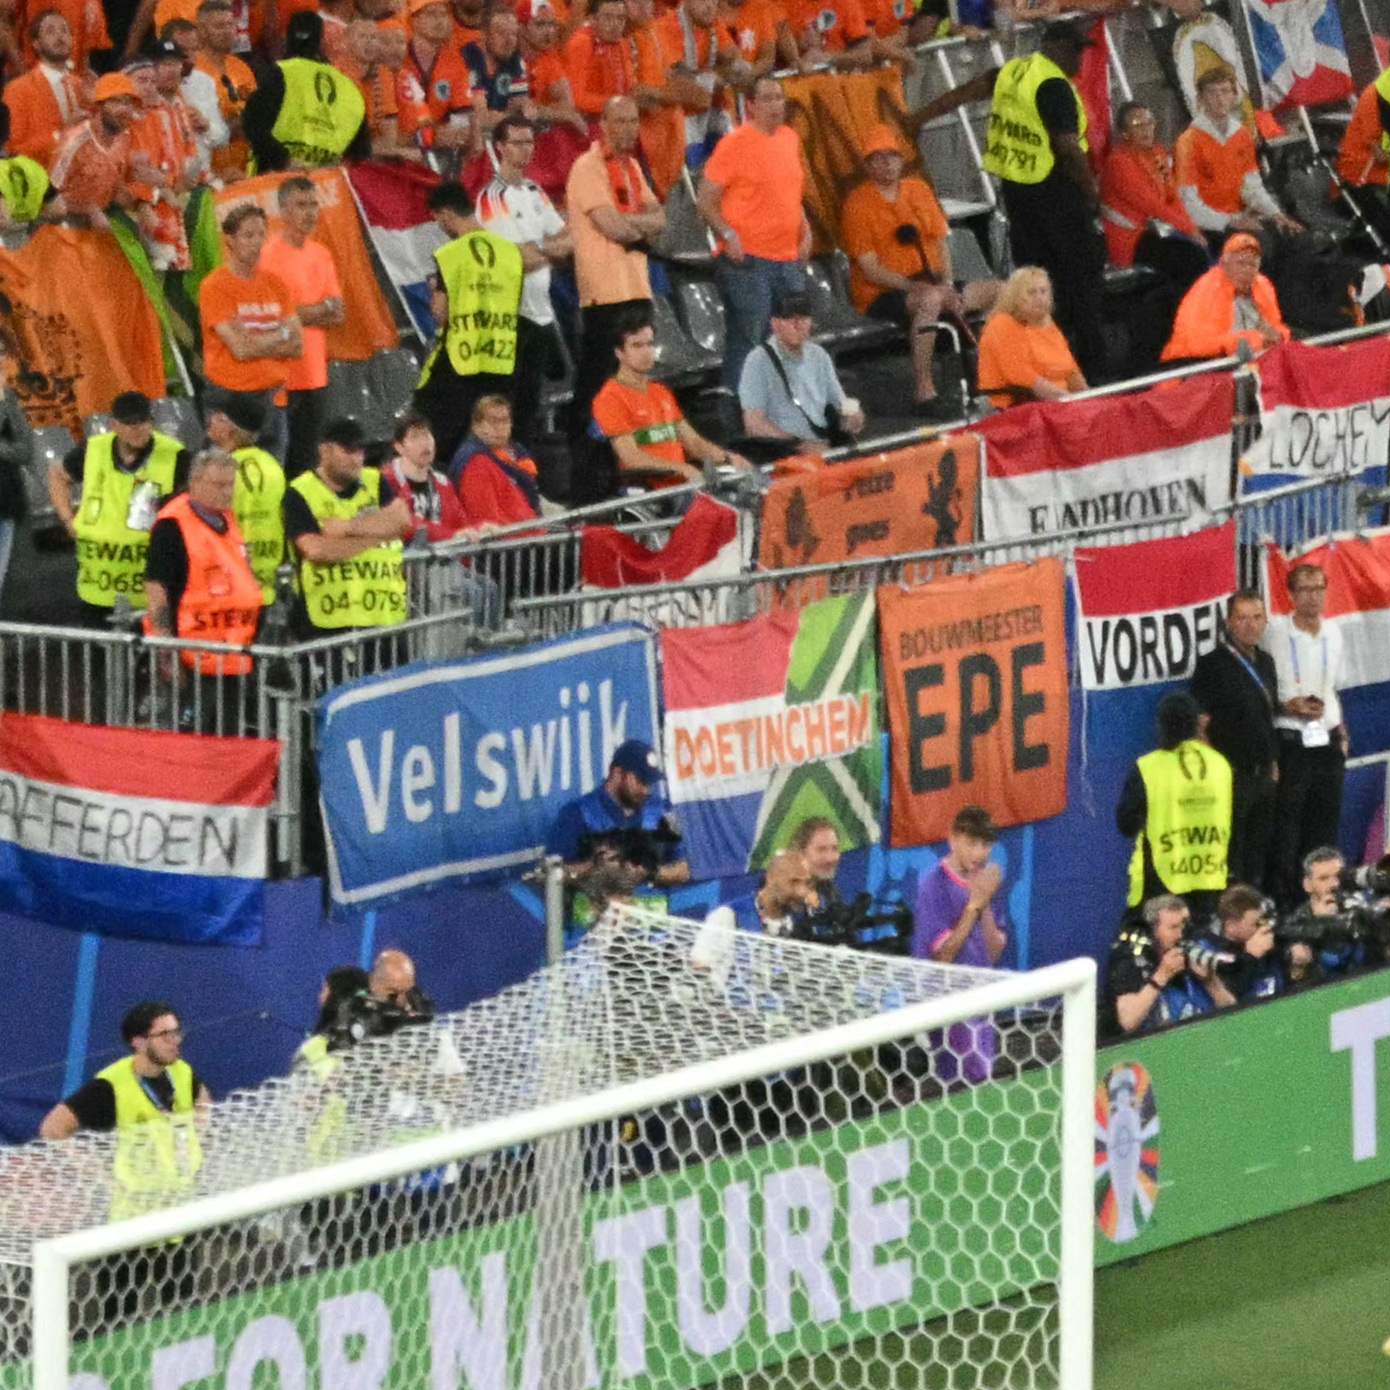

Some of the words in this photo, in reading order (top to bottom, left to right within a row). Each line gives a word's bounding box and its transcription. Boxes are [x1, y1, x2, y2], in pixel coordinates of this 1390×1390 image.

[1028, 474, 1207, 536] ENDHOVEN
[313, 561, 402, 588] STEWAR
[900, 604, 1044, 661] BOUWMEESTER
[674, 691, 872, 781] DOETINCHEM
[904, 641, 1050, 796] EPE
